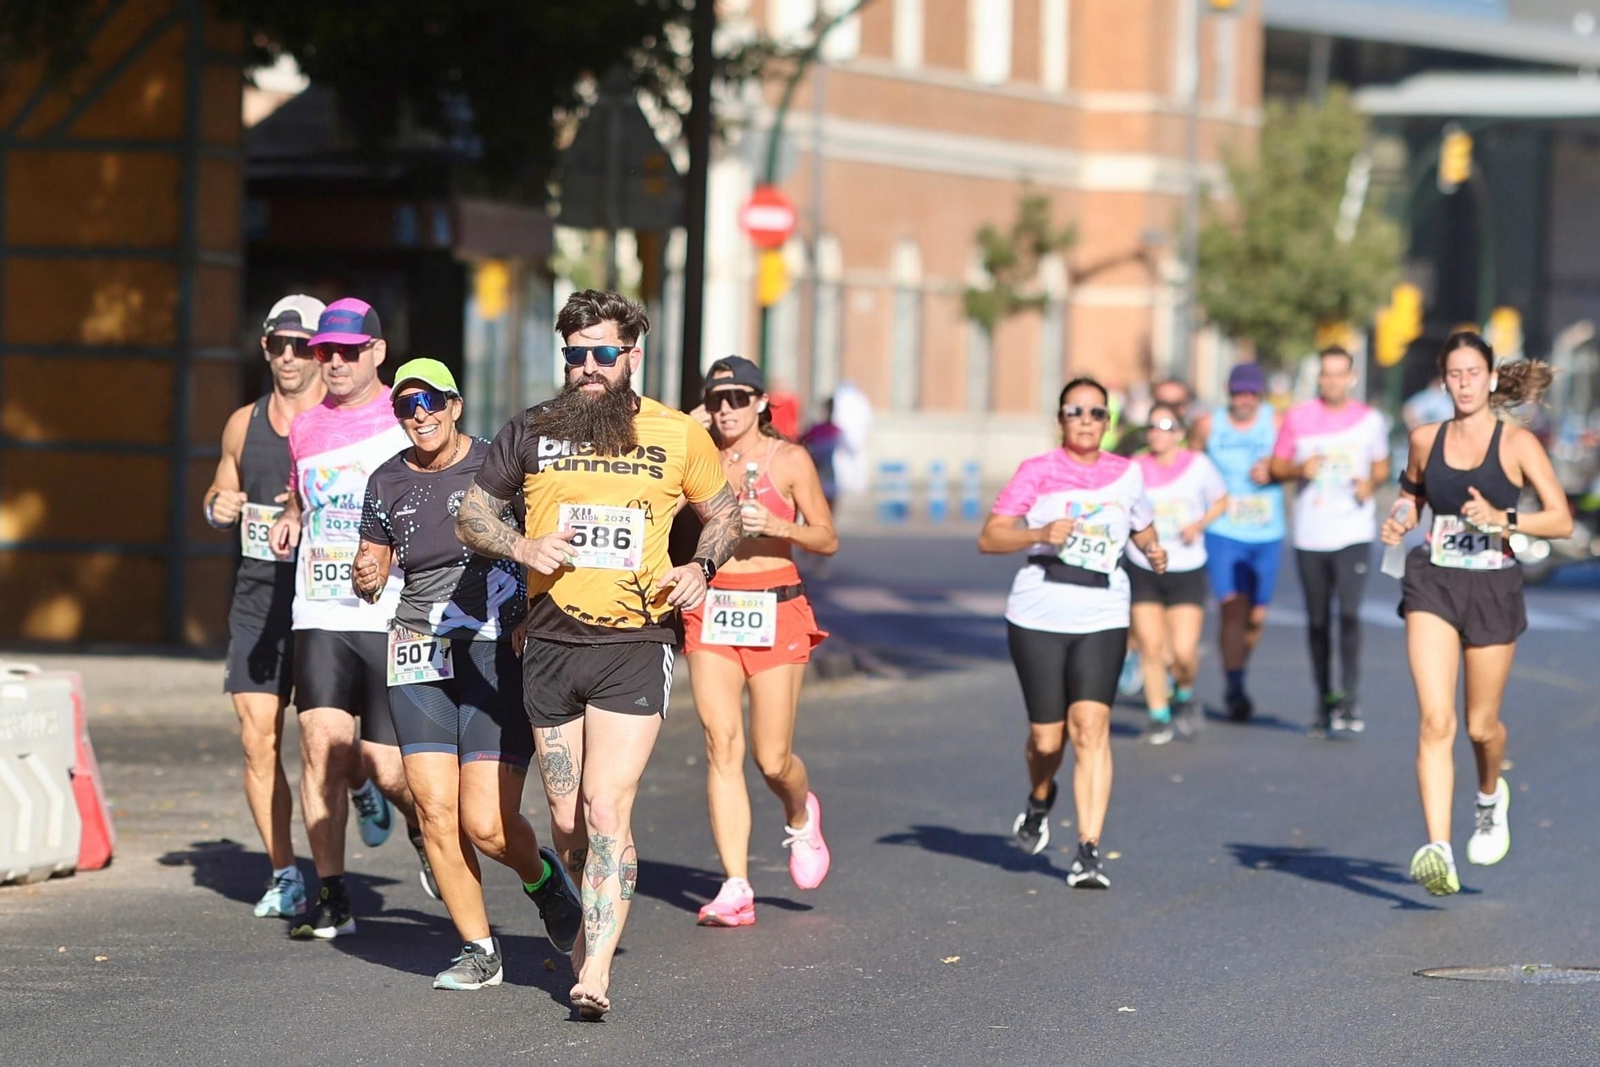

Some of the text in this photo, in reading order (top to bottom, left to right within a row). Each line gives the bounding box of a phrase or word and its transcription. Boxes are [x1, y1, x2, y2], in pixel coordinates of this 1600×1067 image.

[538, 458, 664, 479] runners
[604, 514, 631, 523] 2025
[248, 522, 270, 542] 63
[570, 525, 632, 550] 586
[1067, 535, 1106, 555] 754
[1443, 534, 1490, 552] 241
[313, 563, 352, 582] 503
[714, 610, 763, 629] 480
[396, 641, 437, 666] 507
